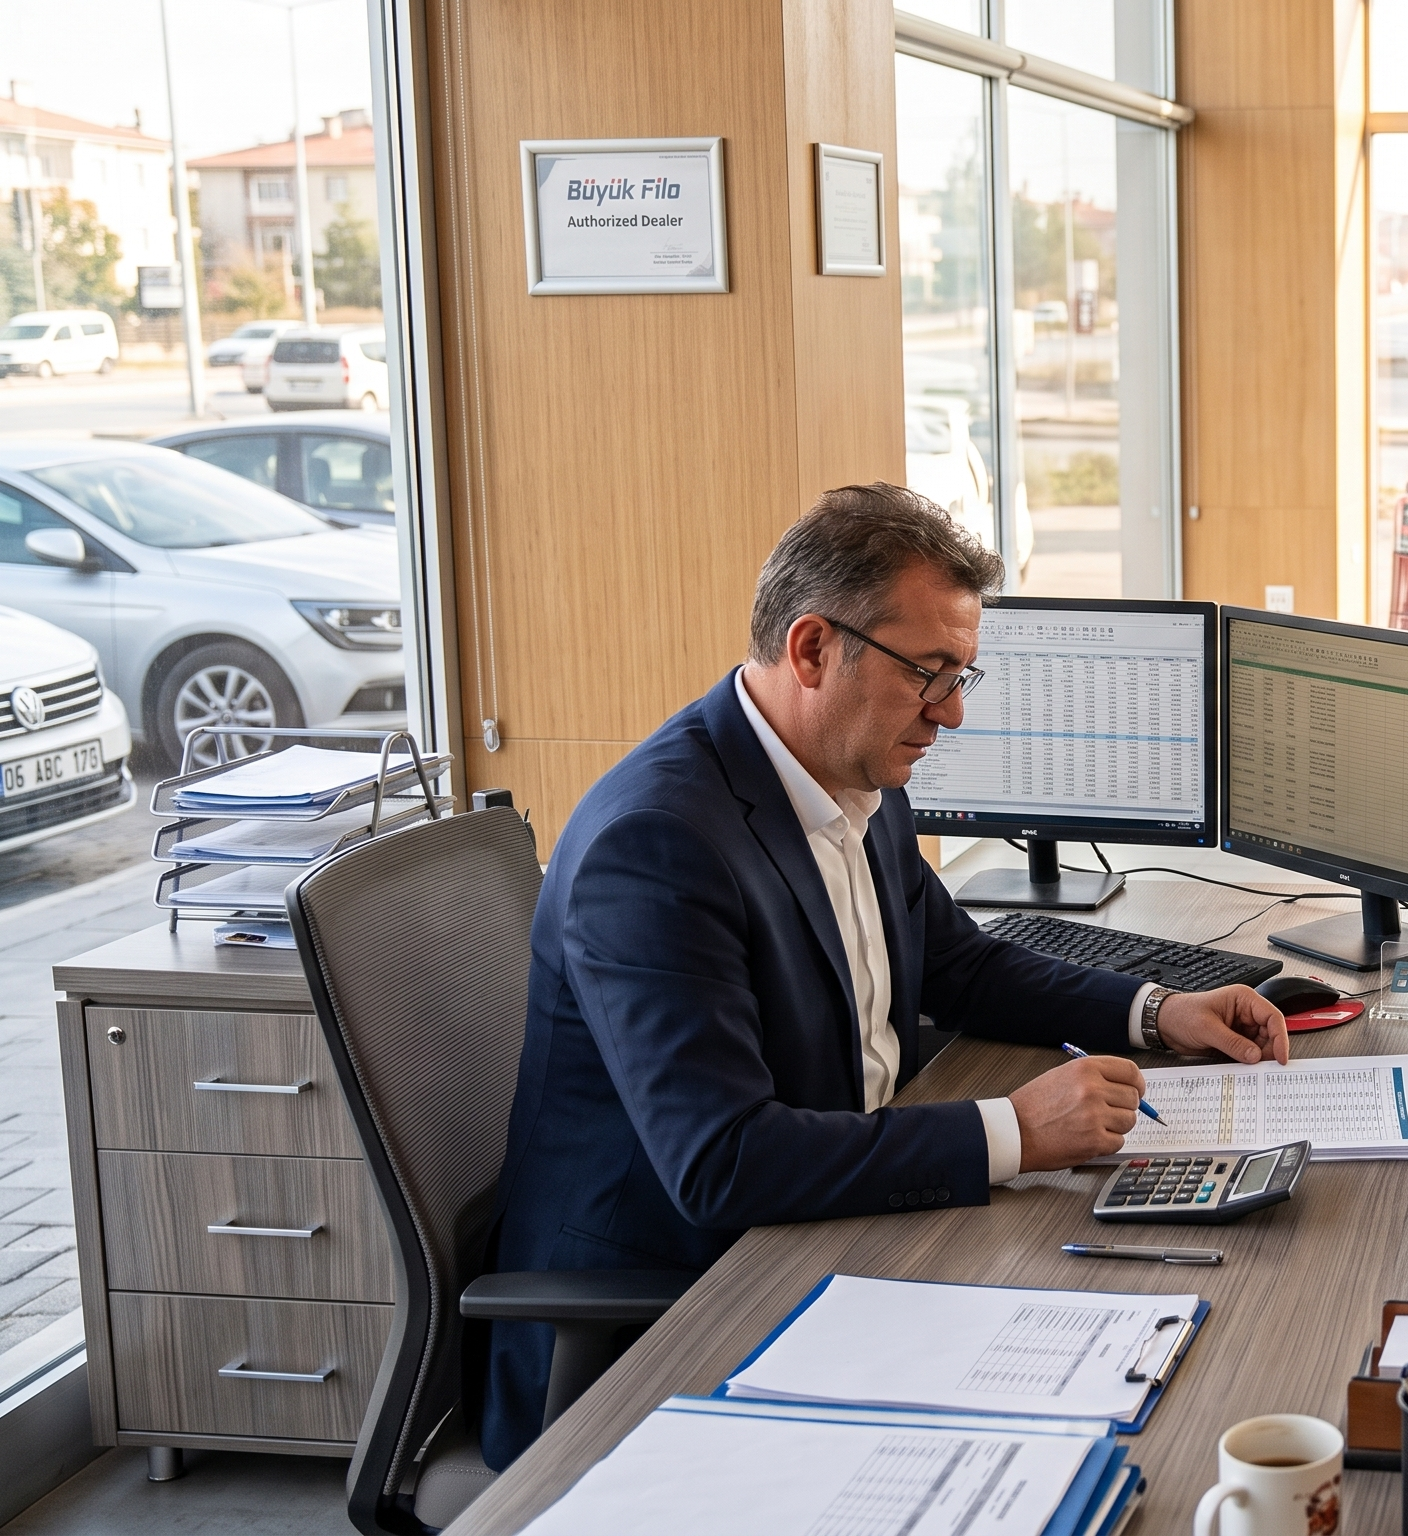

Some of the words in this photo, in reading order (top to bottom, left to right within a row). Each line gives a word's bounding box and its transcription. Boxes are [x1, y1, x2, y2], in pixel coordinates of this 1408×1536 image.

[567, 177, 635, 206] Büyük
[641, 177, 681, 200] Filo
[567, 214, 638, 228] Authorized
[642, 213, 683, 227] Dealer
[5, 766, 24, 791] 06
[37, 756, 63, 783] ABC
